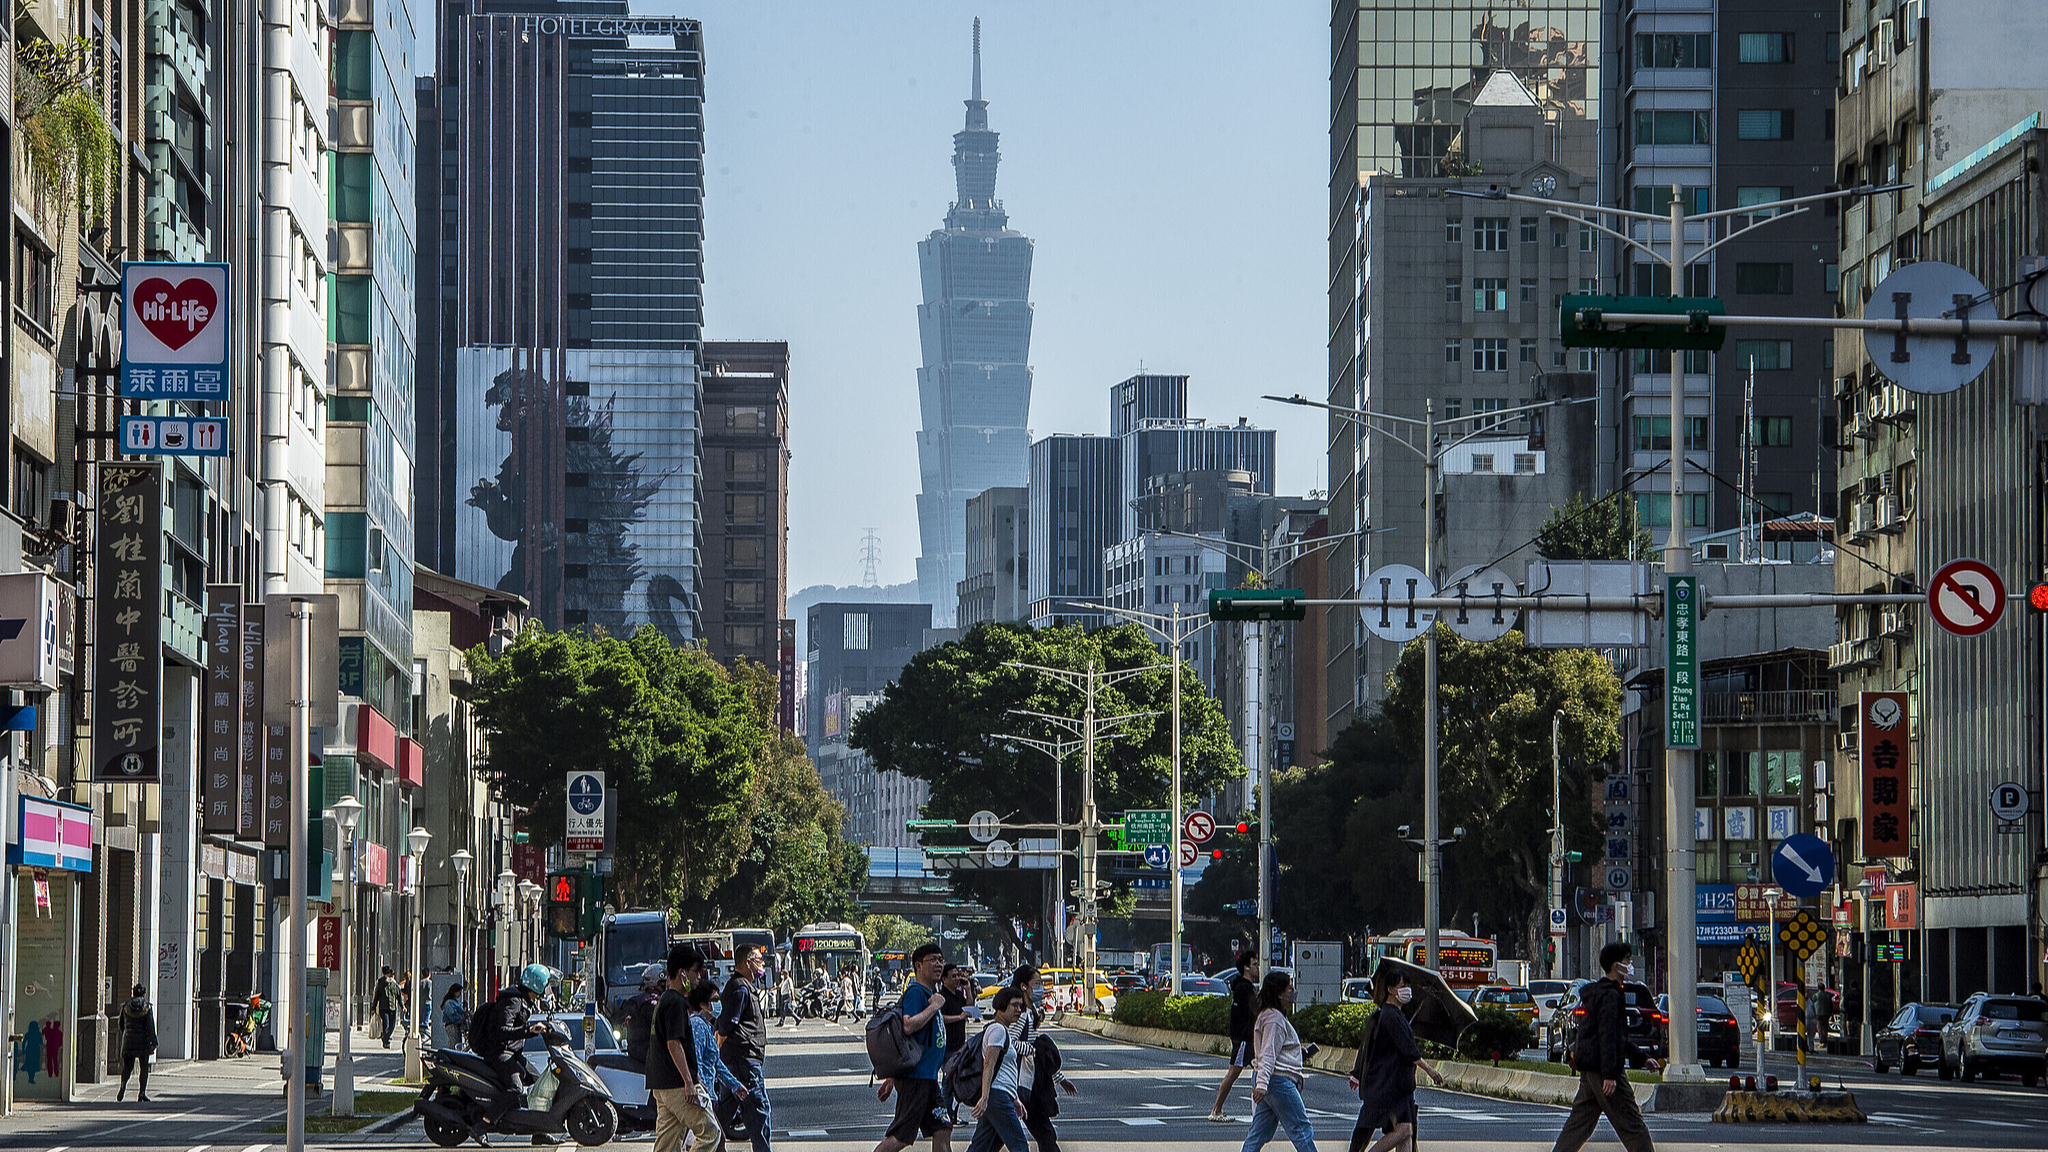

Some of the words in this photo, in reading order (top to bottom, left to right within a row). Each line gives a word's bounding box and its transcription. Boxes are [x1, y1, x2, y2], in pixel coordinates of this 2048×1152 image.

[524, 18, 592, 35] HOTEL
[597, 19, 694, 36] GRACERY
[129, 369, 221, 393] 萊爾富
[109, 494, 148, 748] 劉桂蘭中醫診所
[209, 603, 237, 654] Milano
[244, 621, 261, 670] Milano
[1676, 603, 1689, 684] 忠孝東路一段
[1672, 686, 1692, 695] Zhong
[213, 664, 229, 816] 米蘭時尚診所
[1685, 734, 1694, 743] 112
[268, 726, 284, 833] 蘭時尚診所
[568, 818, 603, 828] 行人優先
[525, 845, 535, 879] 記餅店
[1704, 892, 1735, 909] H25
[322, 919, 334, 969] 台中銀行
[798, 938, 814, 950] 202
[1441, 971, 1474, 980] 55-U5
